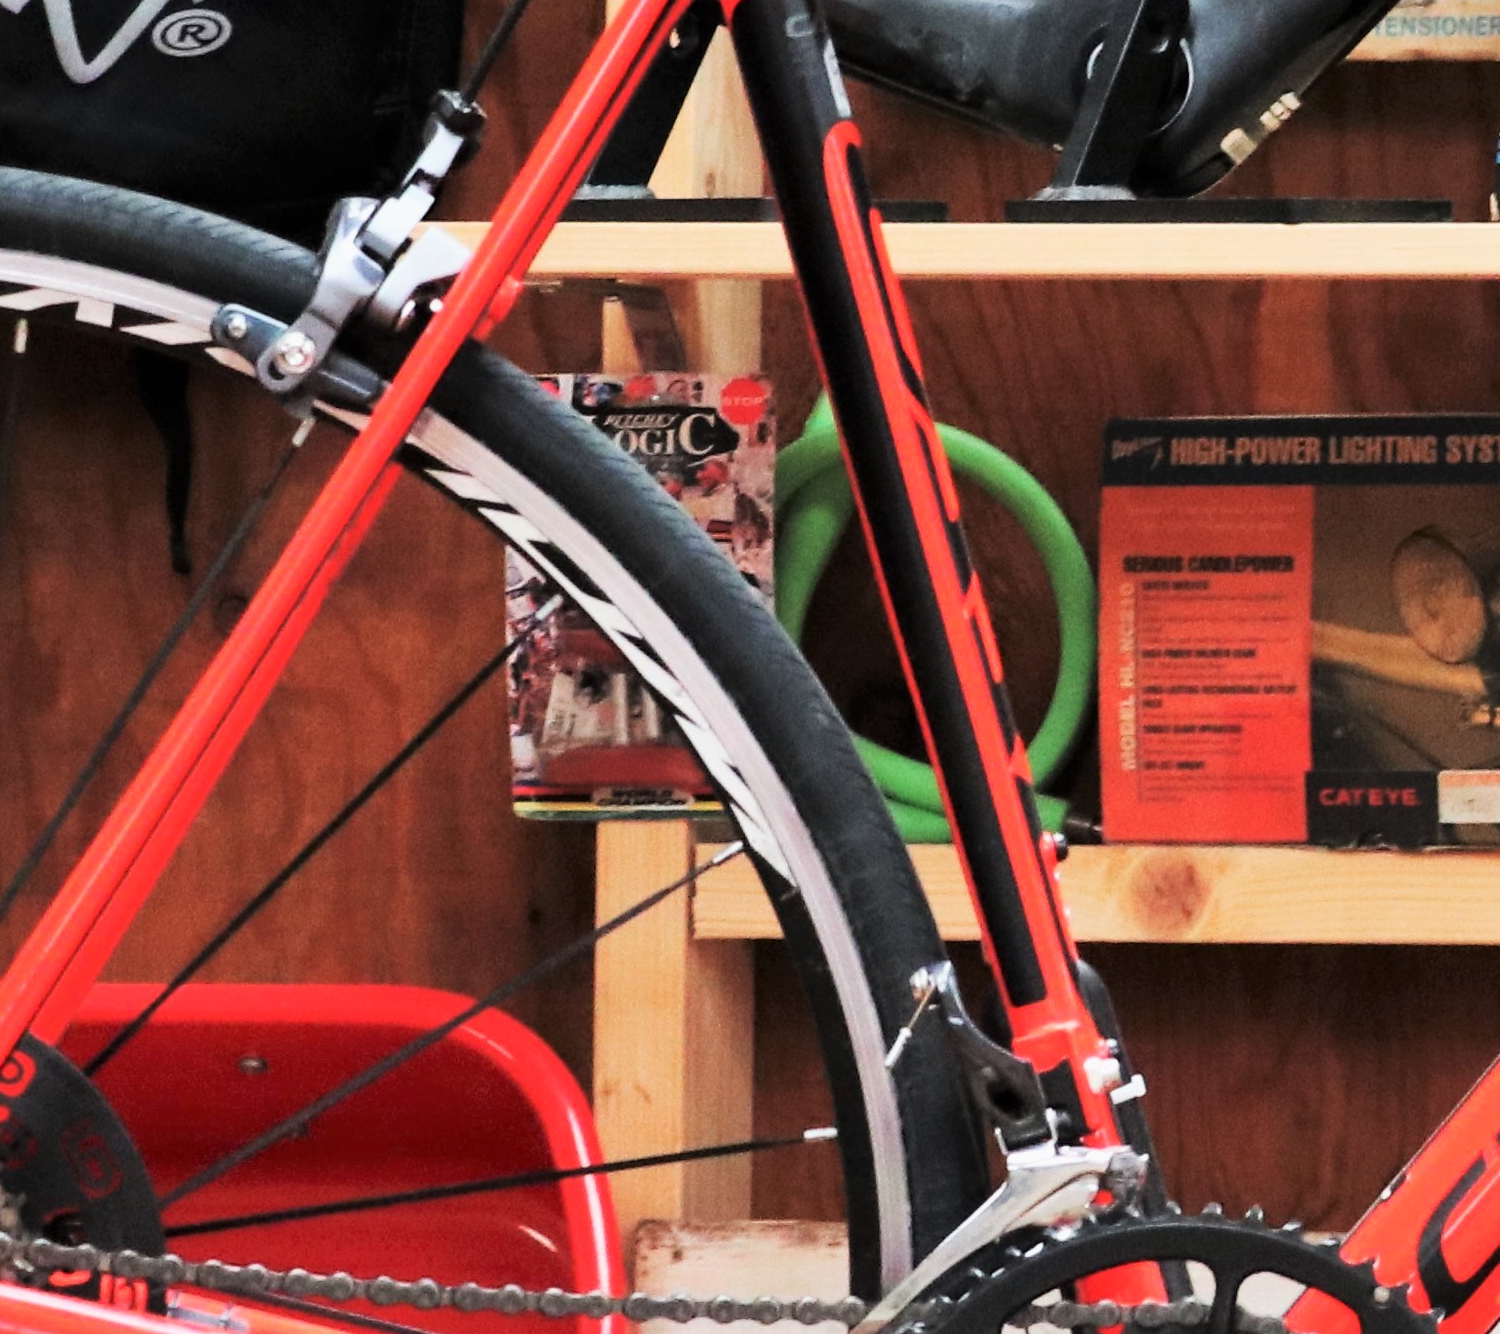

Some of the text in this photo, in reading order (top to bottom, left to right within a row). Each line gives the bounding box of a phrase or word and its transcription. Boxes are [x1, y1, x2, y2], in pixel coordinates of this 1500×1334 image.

[612, 413, 715, 455] OGIC
[1170, 436, 1320, 465] HIGH-POWER
[1328, 434, 1435, 464] LIGHTING
[1118, 695, 1136, 770] MODEL
[1319, 786, 1420, 807] CATEYE
